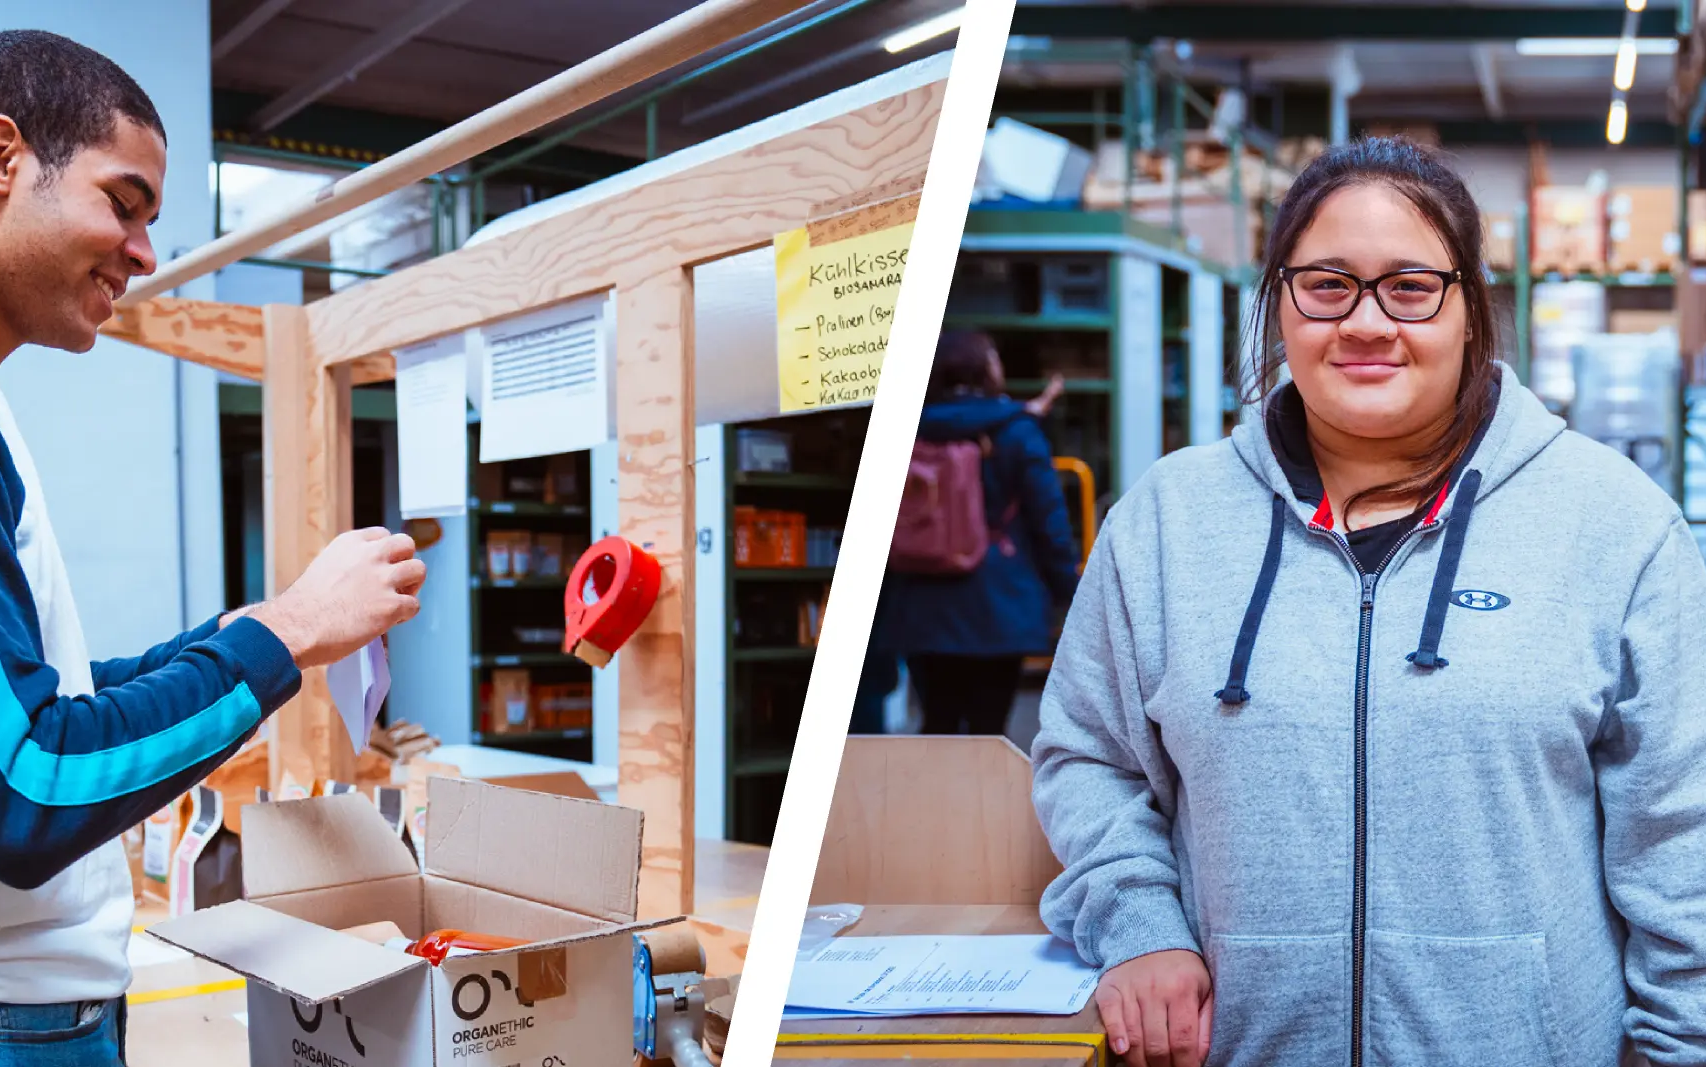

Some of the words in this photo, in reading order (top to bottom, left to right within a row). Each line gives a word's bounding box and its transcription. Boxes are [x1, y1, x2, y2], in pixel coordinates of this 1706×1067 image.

[452, 1016, 535, 1045] ORGANETHIC
[453, 1041, 484, 1059] PURE
[485, 1034, 517, 1052] CARE
